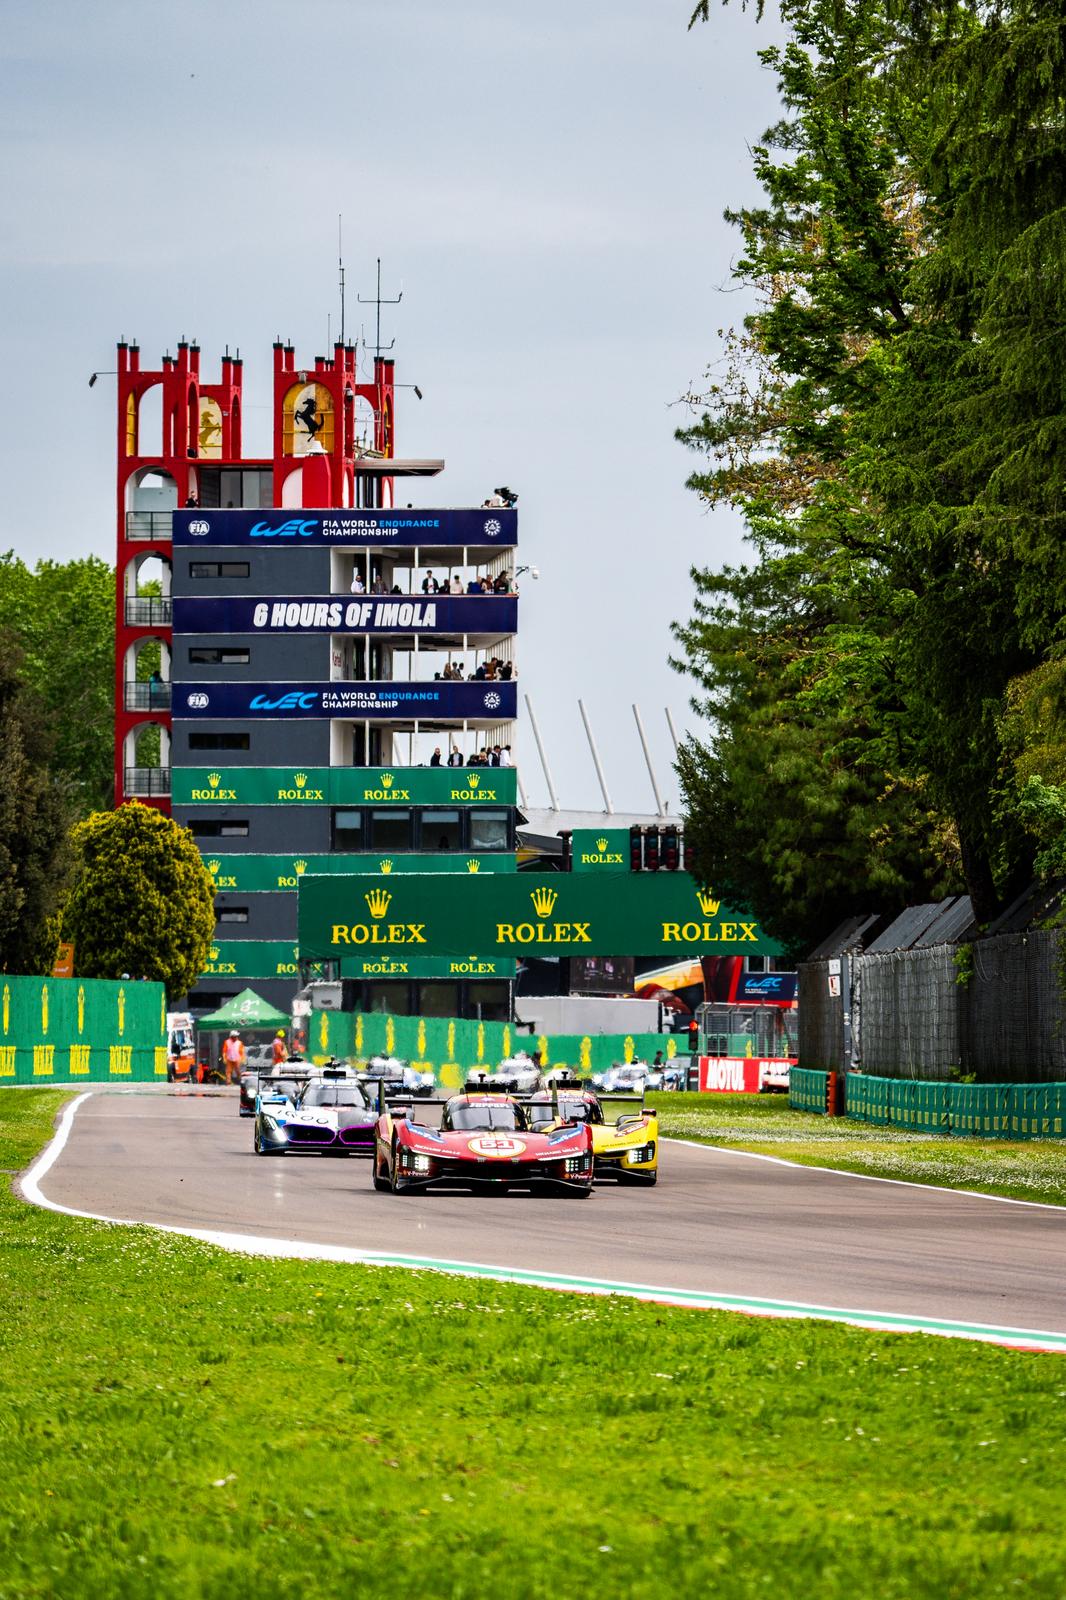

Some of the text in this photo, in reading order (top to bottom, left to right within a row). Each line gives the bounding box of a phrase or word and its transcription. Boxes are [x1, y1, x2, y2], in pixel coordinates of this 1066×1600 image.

[190, 523, 208, 533] FIA
[250, 519, 319, 537] WEC
[322, 519, 440, 528] FIA WORLD ENDURANCE
[322, 528, 399, 537] CHAMPIONSHIP
[253, 603, 437, 628] 6 HOURS OF IMOLA
[188, 696, 208, 706] FIA
[250, 691, 319, 710] WEC
[322, 692, 440, 700] FIA WORLD ENDURANCE
[322, 700, 399, 709] CHAMPIONSHIP
[191, 790, 237, 800] ROLEX
[278, 790, 324, 800] ROLEX
[364, 790, 410, 800] ROLEX
[450, 790, 497, 800] ROLEX
[581, 854, 624, 864] ROLEX
[212, 877, 237, 887] LEX
[331, 924, 427, 945] ROLEX
[496, 922, 592, 943] ROLEX
[661, 922, 758, 942] ROLEX
[203, 963, 237, 973] OLEX
[362, 963, 408, 973] ROLEX
[450, 963, 496, 973] ROLEX
[745, 977, 783, 988] WEC
[706, 1059, 745, 1092] MOTUL
[480, 1140, 514, 1150] 51
